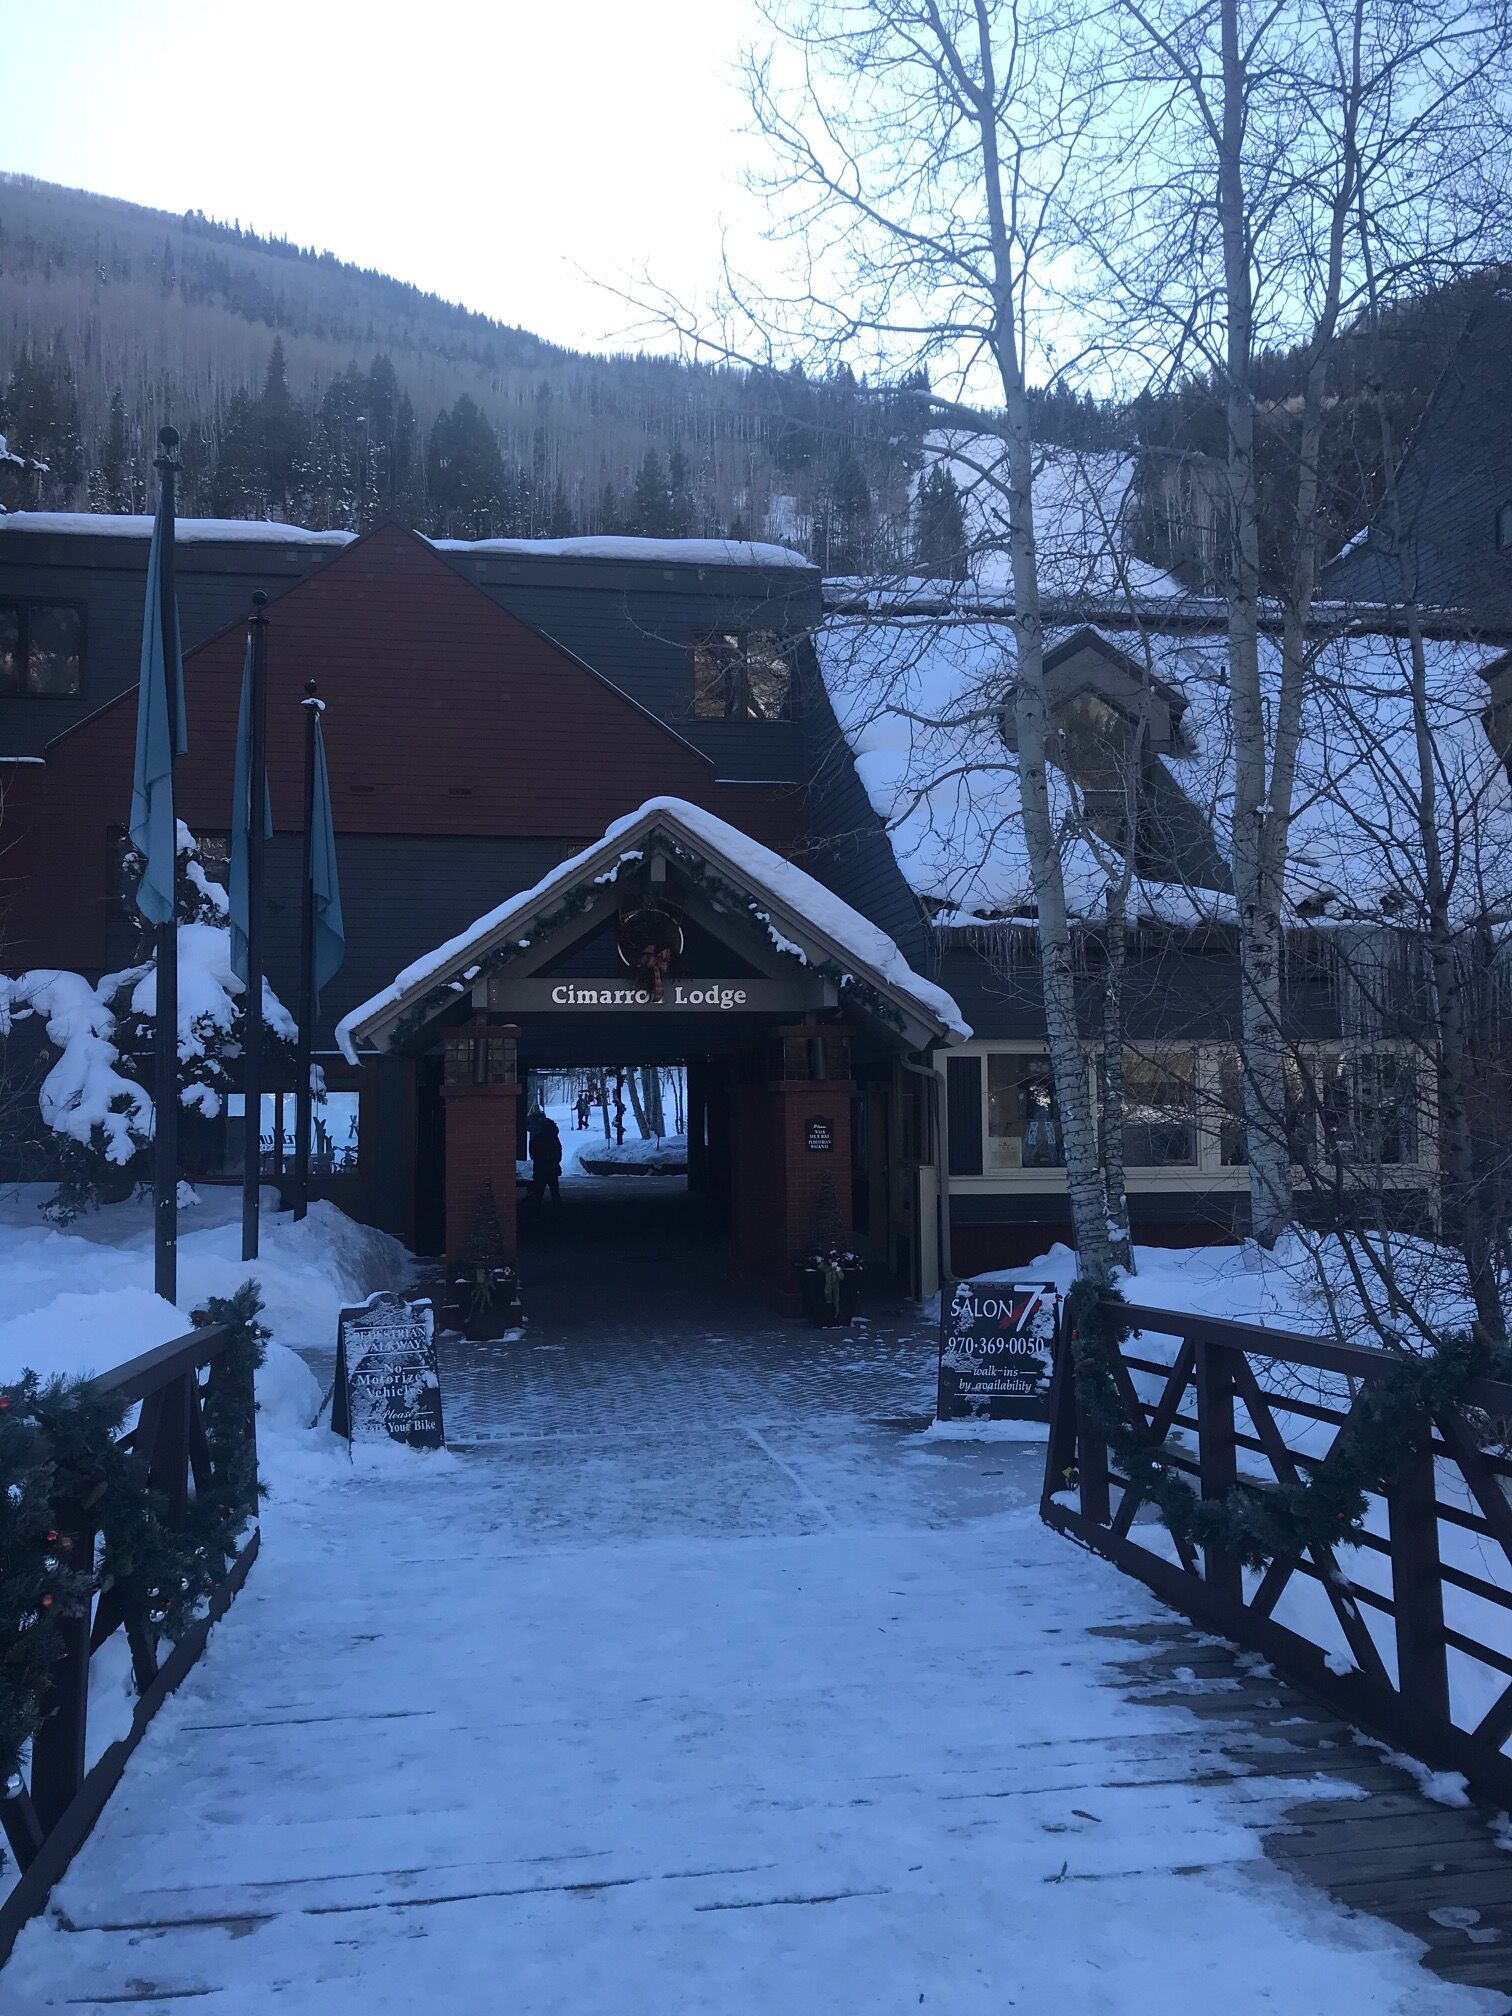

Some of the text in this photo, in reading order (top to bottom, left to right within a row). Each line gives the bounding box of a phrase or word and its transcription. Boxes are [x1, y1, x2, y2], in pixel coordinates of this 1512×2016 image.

[551, 985, 748, 1009] Cimarro Lodge
[950, 1284, 1047, 1332] SALON 7
[383, 1363, 403, 1374] No
[973, 1365, 1019, 1377] walk-ins
[356, 1371, 426, 1386] Motorize
[958, 1378, 1032, 1393] by availability
[365, 1384, 424, 1400] Vehicls
[382, 1409, 415, 1420] Please
[413, 1419, 436, 1432] Bike
